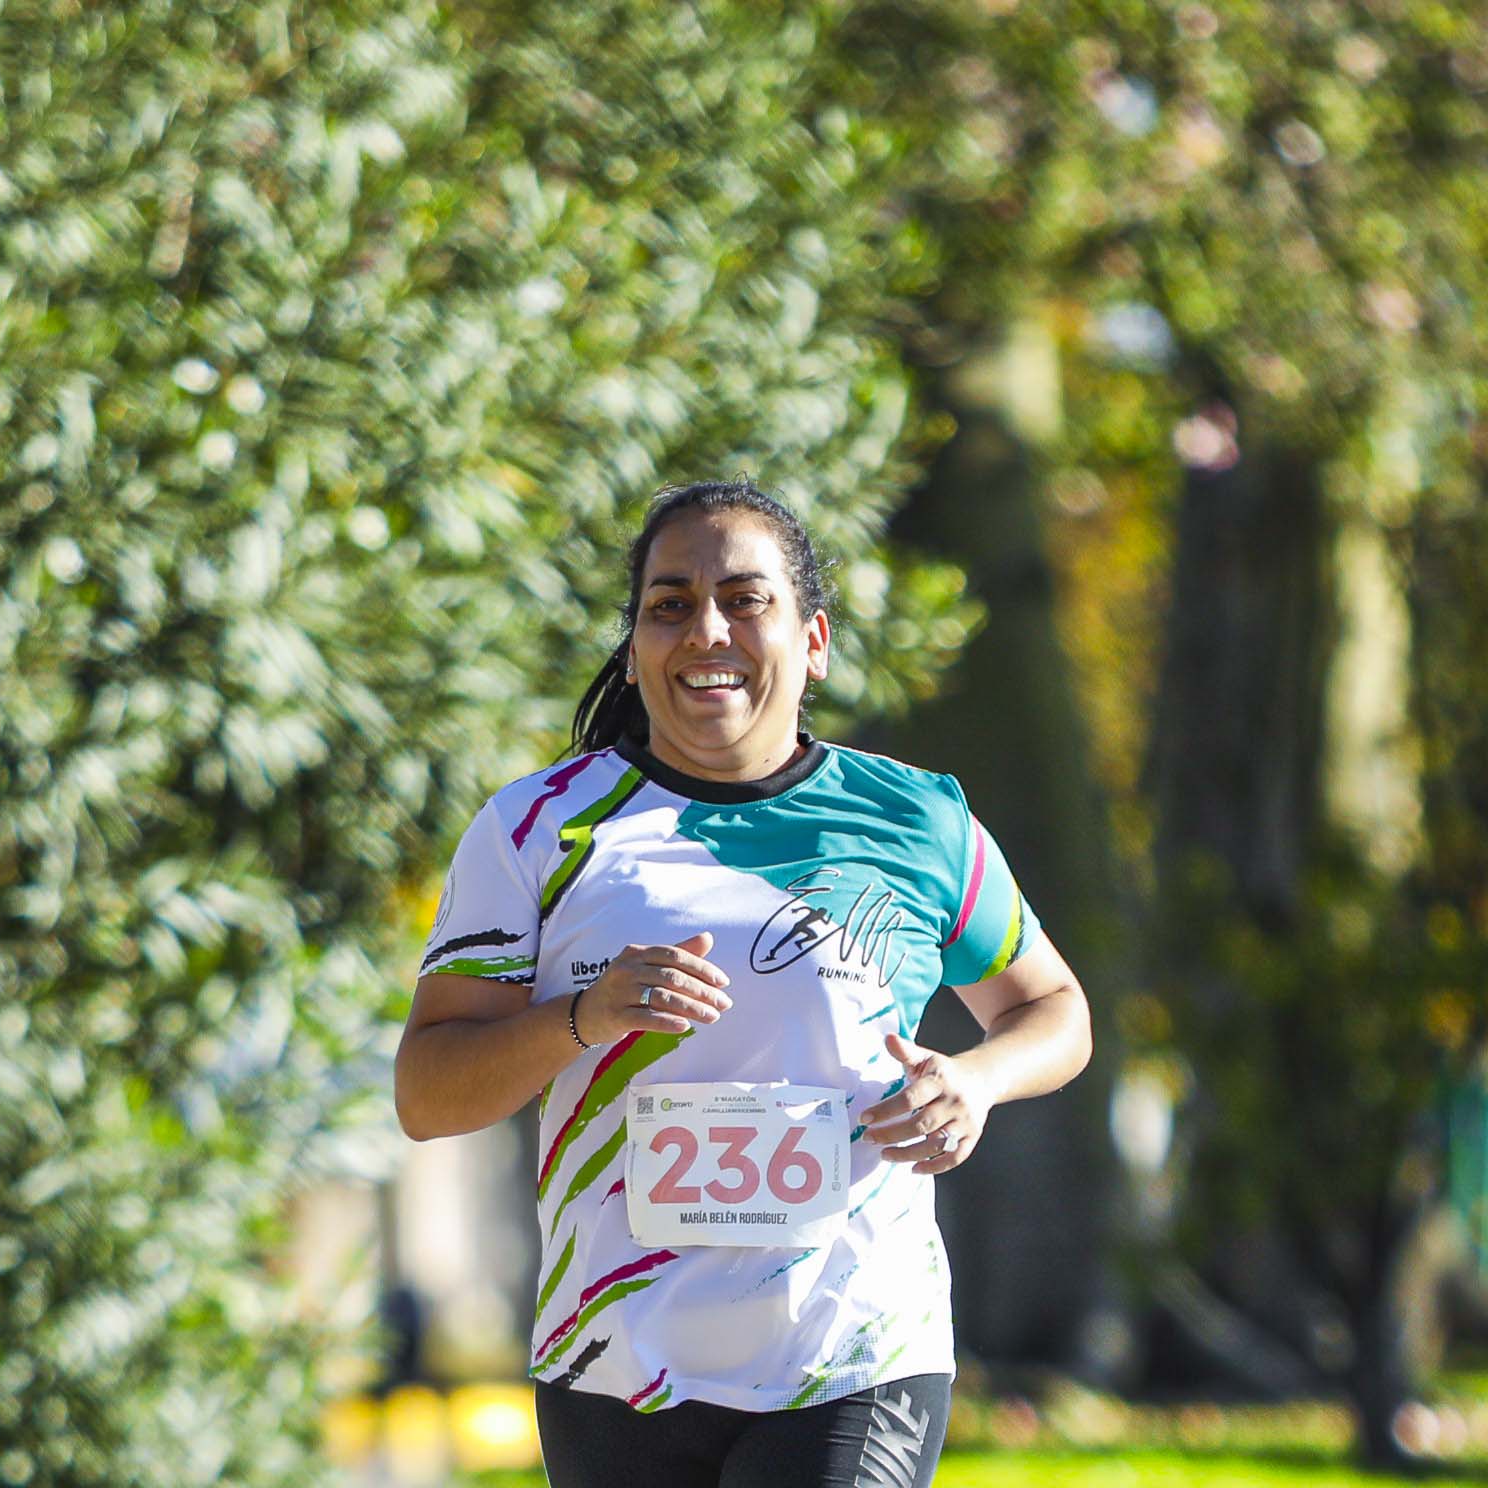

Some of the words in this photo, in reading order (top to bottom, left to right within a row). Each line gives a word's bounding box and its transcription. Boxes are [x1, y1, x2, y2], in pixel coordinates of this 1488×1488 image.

[817, 966, 867, 984] RUNNING
[648, 1126, 823, 1204] 236
[680, 1211, 708, 1225] MARÍA
[709, 1211, 737, 1224] BELÉN
[738, 1211, 788, 1225] RODRÍGUEZ
